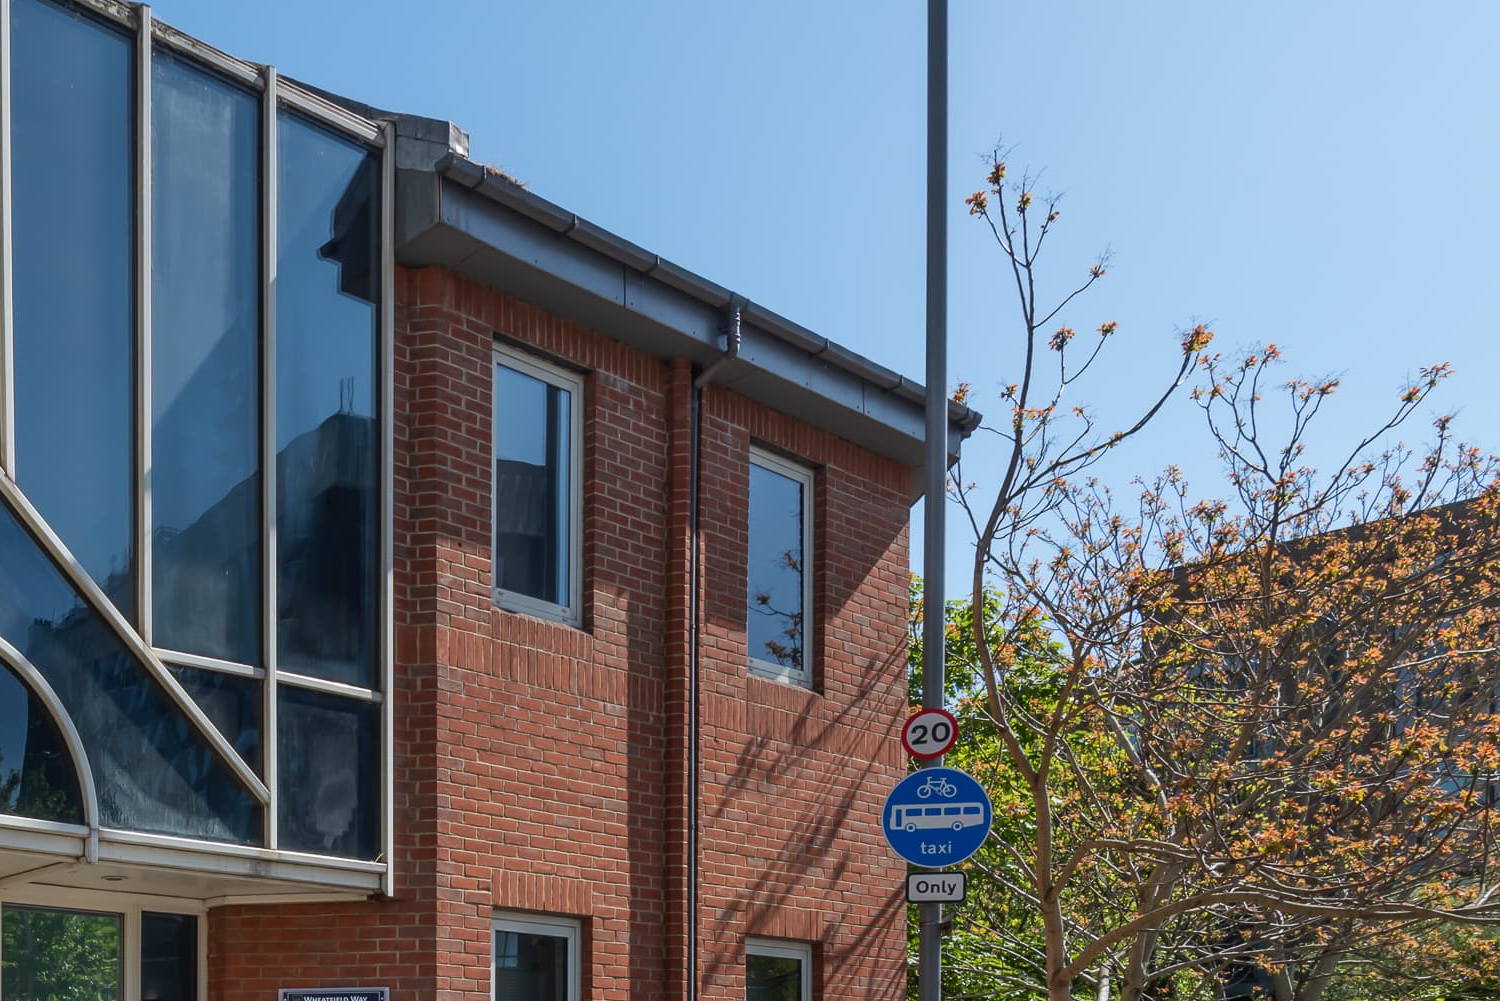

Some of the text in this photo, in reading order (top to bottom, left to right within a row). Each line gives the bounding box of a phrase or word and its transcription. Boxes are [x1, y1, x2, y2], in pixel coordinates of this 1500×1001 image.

[911, 721, 950, 745] 20
[920, 841, 952, 854] taxi
[916, 880, 956, 895] Only
